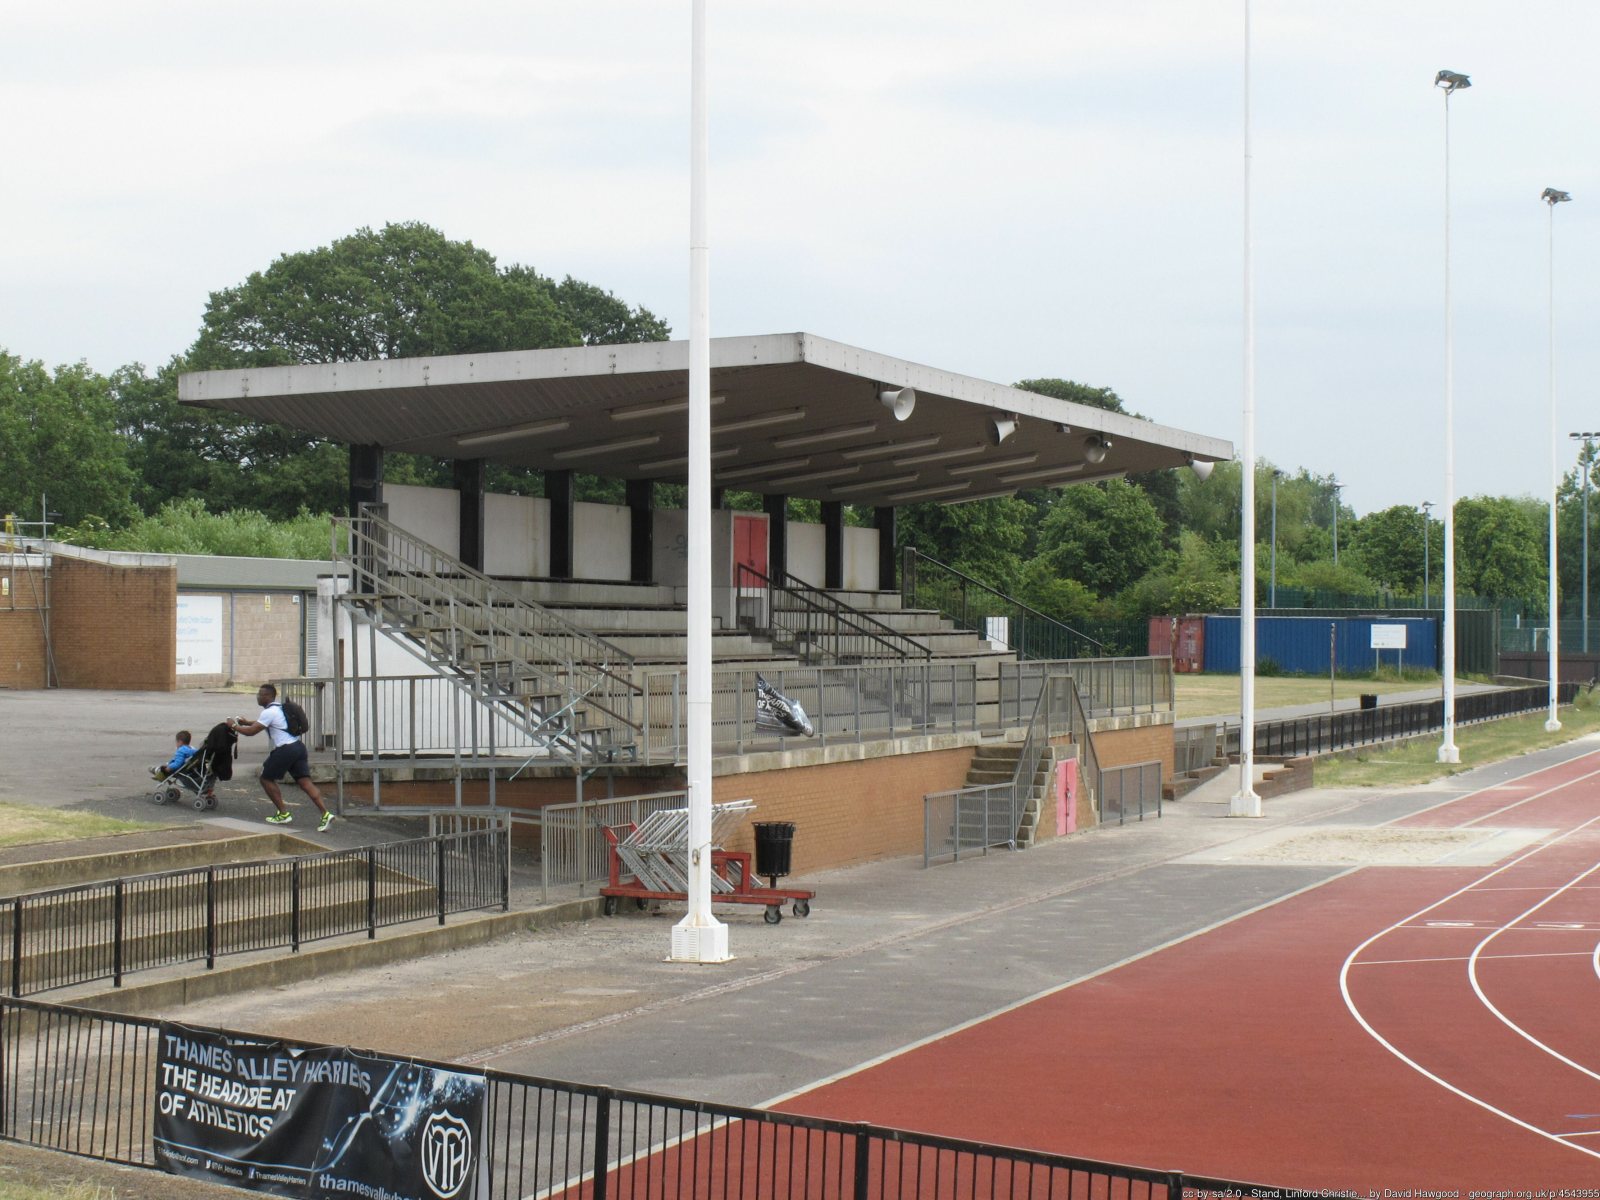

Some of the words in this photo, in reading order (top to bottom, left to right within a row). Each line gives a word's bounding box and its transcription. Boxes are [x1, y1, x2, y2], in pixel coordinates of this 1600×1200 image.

[165, 1035, 232, 1073] THAMES
[233, 1057, 303, 1082] ALLEY
[162, 1063, 198, 1093] THE
[198, 1072, 297, 1112] HEARTBEAT
[159, 1092, 186, 1116] OF
[187, 1100, 274, 1138] ATHLETICS
